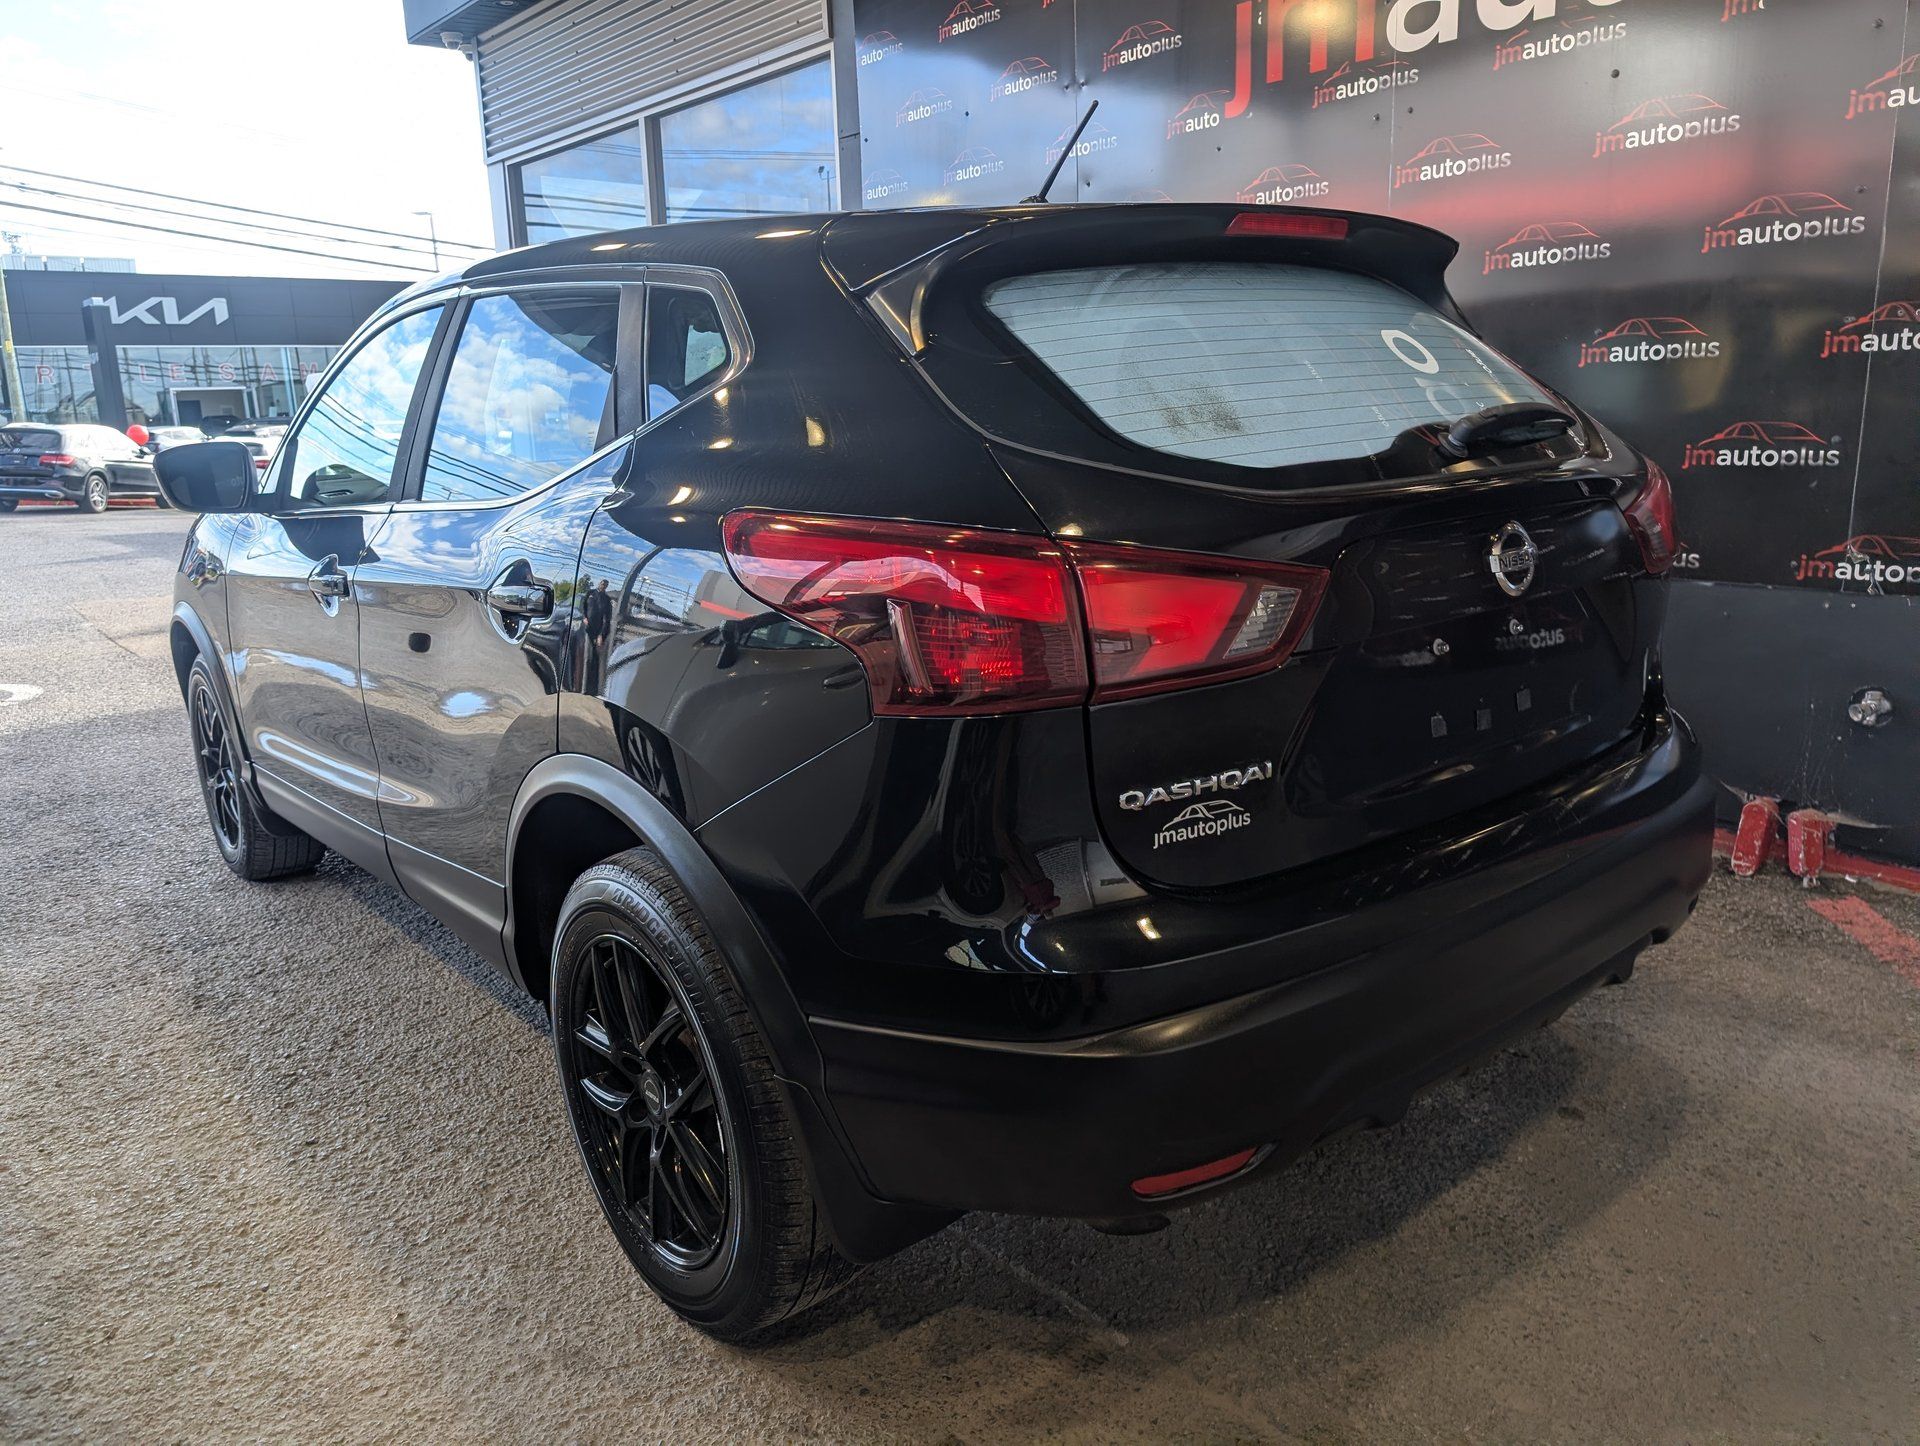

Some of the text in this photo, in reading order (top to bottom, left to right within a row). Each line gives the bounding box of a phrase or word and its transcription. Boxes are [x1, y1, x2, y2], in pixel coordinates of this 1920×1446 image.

[938, 8, 1001, 43] jmautoplus
[1102, 33, 1182, 72] jmautoplus
[1493, 19, 1627, 71] jmautoplus
[990, 69, 1057, 102] jmautoplus
[1312, 66, 1419, 109] jmautoplus
[1166, 112, 1220, 140] jmauto
[1592, 113, 1742, 159] jmautoplus
[1394, 150, 1512, 189] jmautoplus
[1701, 214, 1866, 254] jmautoplus
[1482, 240, 1612, 276] jmautoplus
[103, 296, 230, 326] KIA
[1578, 338, 1721, 368] jmautoplus
[1682, 444, 1840, 470] jmautoplus
[1499, 553, 1534, 571] NISS
[1118, 760, 1273, 812] QASHQAI
[1153, 812, 1251, 850] jmautoplus
[611, 887, 716, 1025] BRIDGESTO
